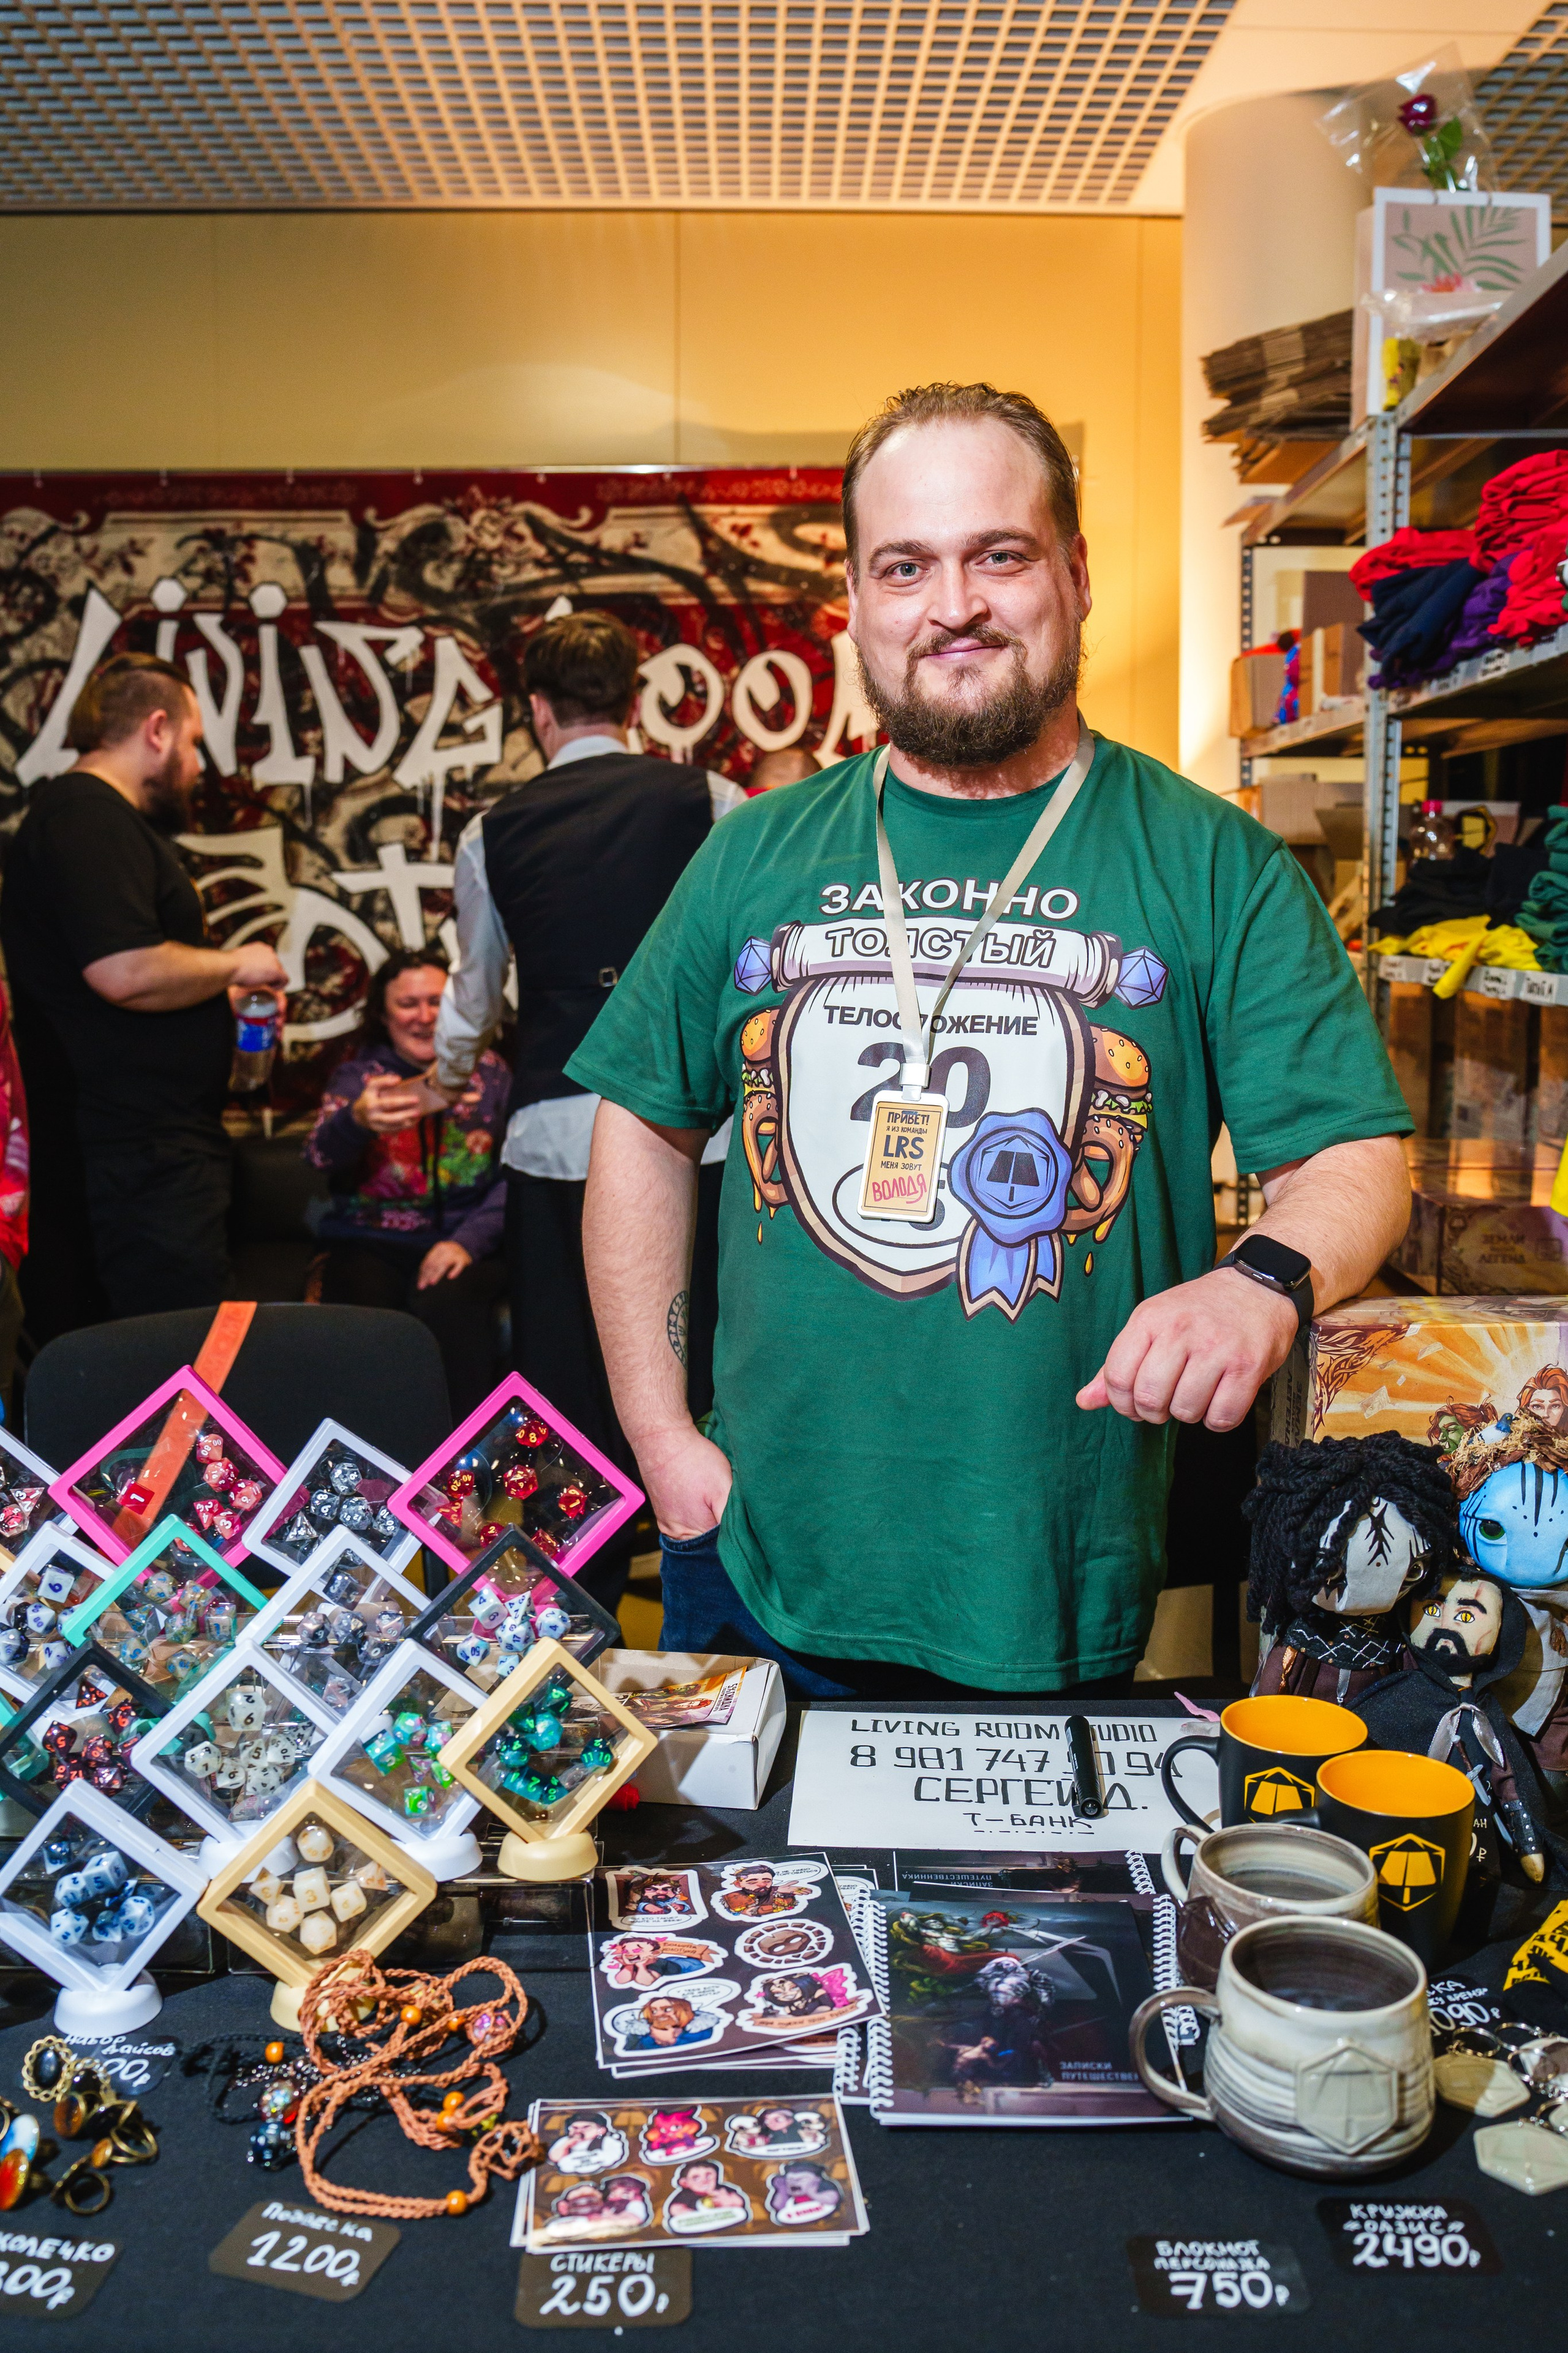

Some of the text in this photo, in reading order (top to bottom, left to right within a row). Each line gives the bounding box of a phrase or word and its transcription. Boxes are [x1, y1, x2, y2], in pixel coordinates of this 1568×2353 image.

[819, 877, 1080, 921] ЗАКОННО
[887, 1111, 930, 1125] ПРИВЕТ!
[883, 1135, 924, 1160] LRS
[900, 1163, 922, 1171] ЗОВУТ
[872, 1173, 927, 1204] ВОЛОДЯ
[851, 1719, 1158, 1742] LIVING ROOM TUDIO
[850, 1745, 876, 1767] 8
[976, 1748, 1050, 1772] 747
[1062, 1751, 1116, 1775] 0
[1060, 2061, 1112, 2070] ЗАПИСКИ
[1349, 2204, 1448, 2220] КРУЖКА
[1155, 2239, 1260, 2256] БЛОКНОТ
[551, 2253, 654, 2274] СТИКЕРЫ
